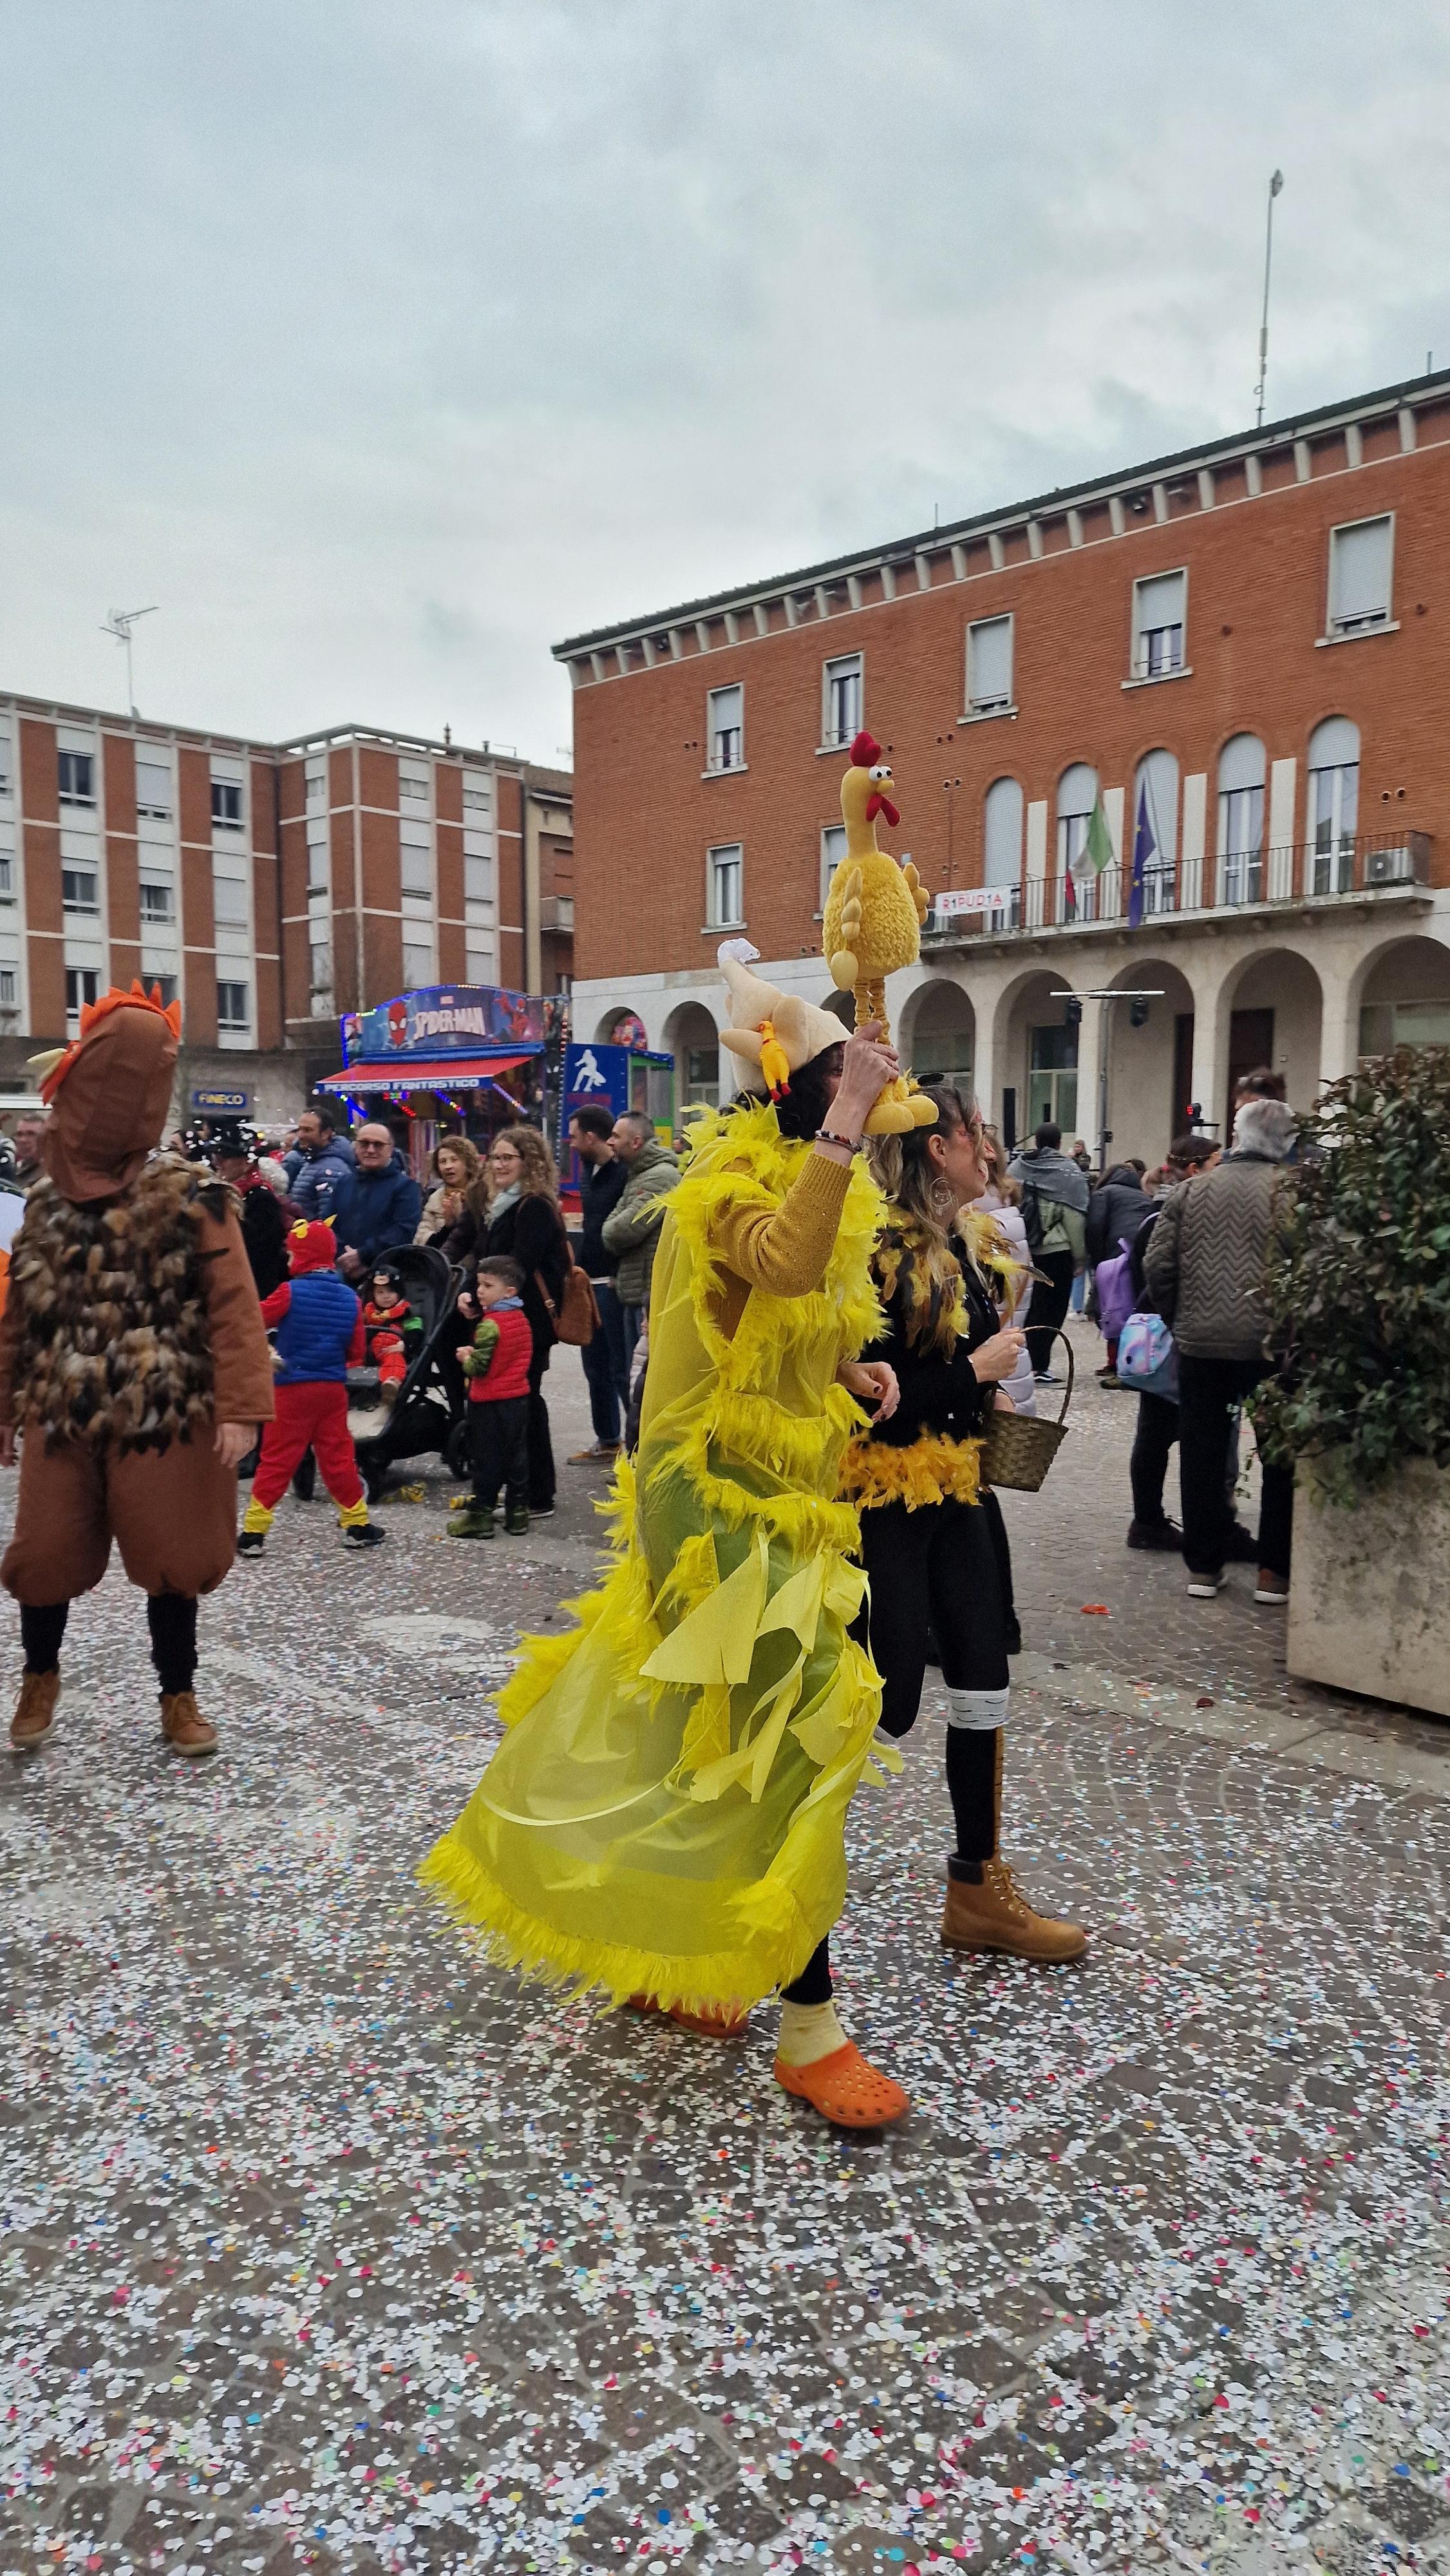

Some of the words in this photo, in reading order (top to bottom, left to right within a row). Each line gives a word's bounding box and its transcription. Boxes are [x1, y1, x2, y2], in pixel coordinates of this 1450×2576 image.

[413, 1007, 485, 1041] SPIDER-MAN
[324, 1083, 390, 1092] PERCORSO
[392, 1079, 480, 1090] FANTASTICO
[198, 1094, 244, 1104] FINECO
